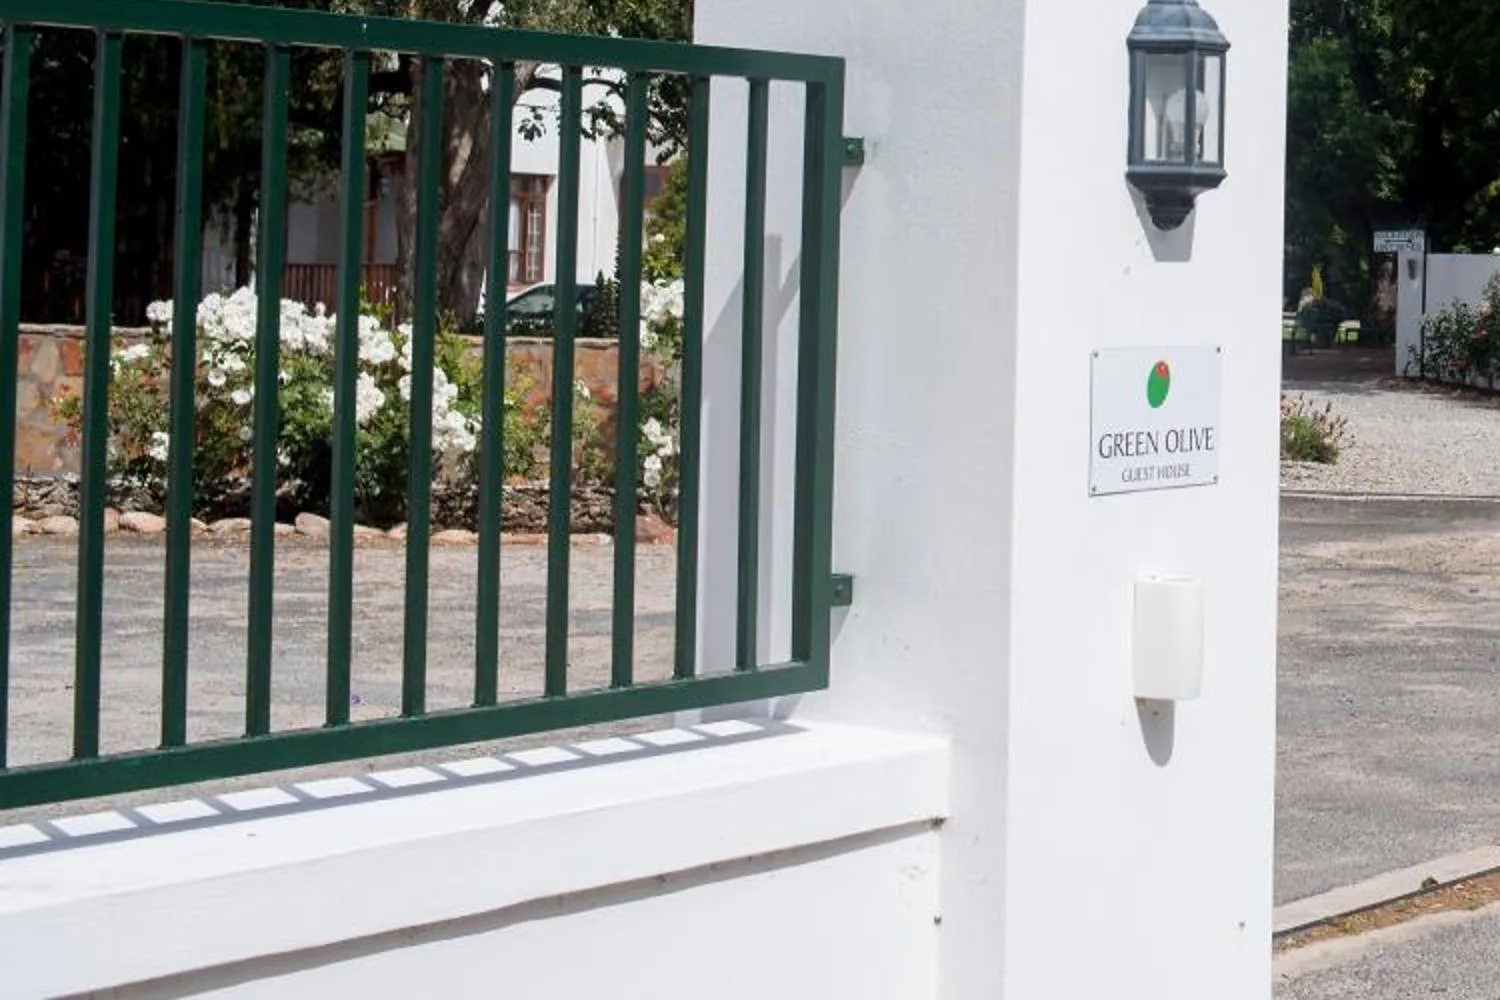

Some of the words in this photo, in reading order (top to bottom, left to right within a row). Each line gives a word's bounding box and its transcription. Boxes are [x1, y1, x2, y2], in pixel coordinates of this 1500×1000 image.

[1099, 430, 1159, 458] GREEN
[1165, 427, 1214, 453] OLIVE
[1121, 466, 1155, 482] GUEST
[1157, 463, 1190, 480] HOUSE
